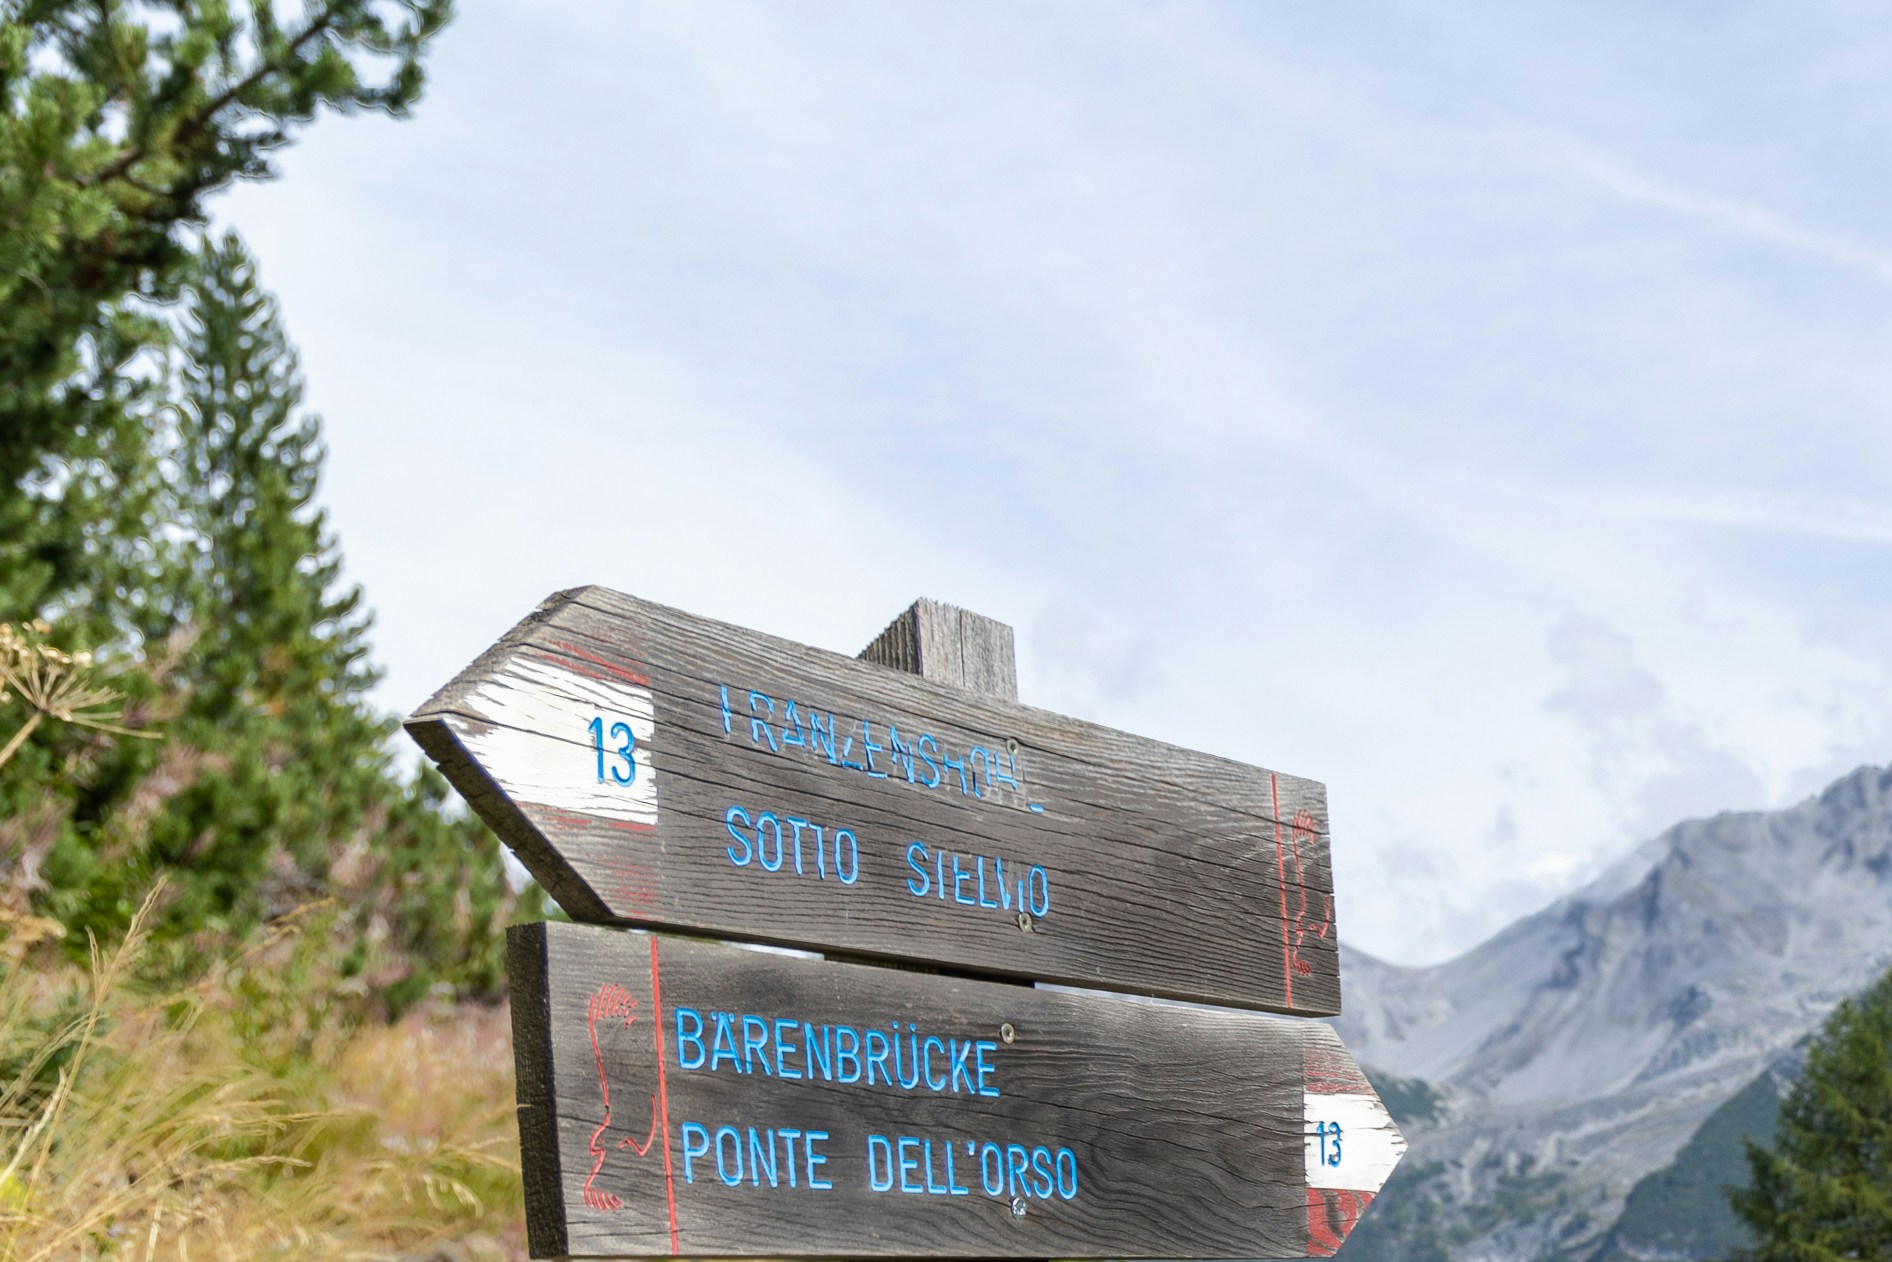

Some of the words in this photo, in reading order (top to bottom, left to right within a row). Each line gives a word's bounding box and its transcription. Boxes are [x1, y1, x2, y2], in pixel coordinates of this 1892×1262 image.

[587, 715, 637, 786] 13
[723, 804, 861, 883] SOTTO
[673, 1005, 1002, 1099] BÄRENBRÜCKE
[679, 1120, 835, 1192] PONTE
[865, 1132, 1080, 1202] DELL'ORSO
[1315, 1120, 1343, 1169] 13
